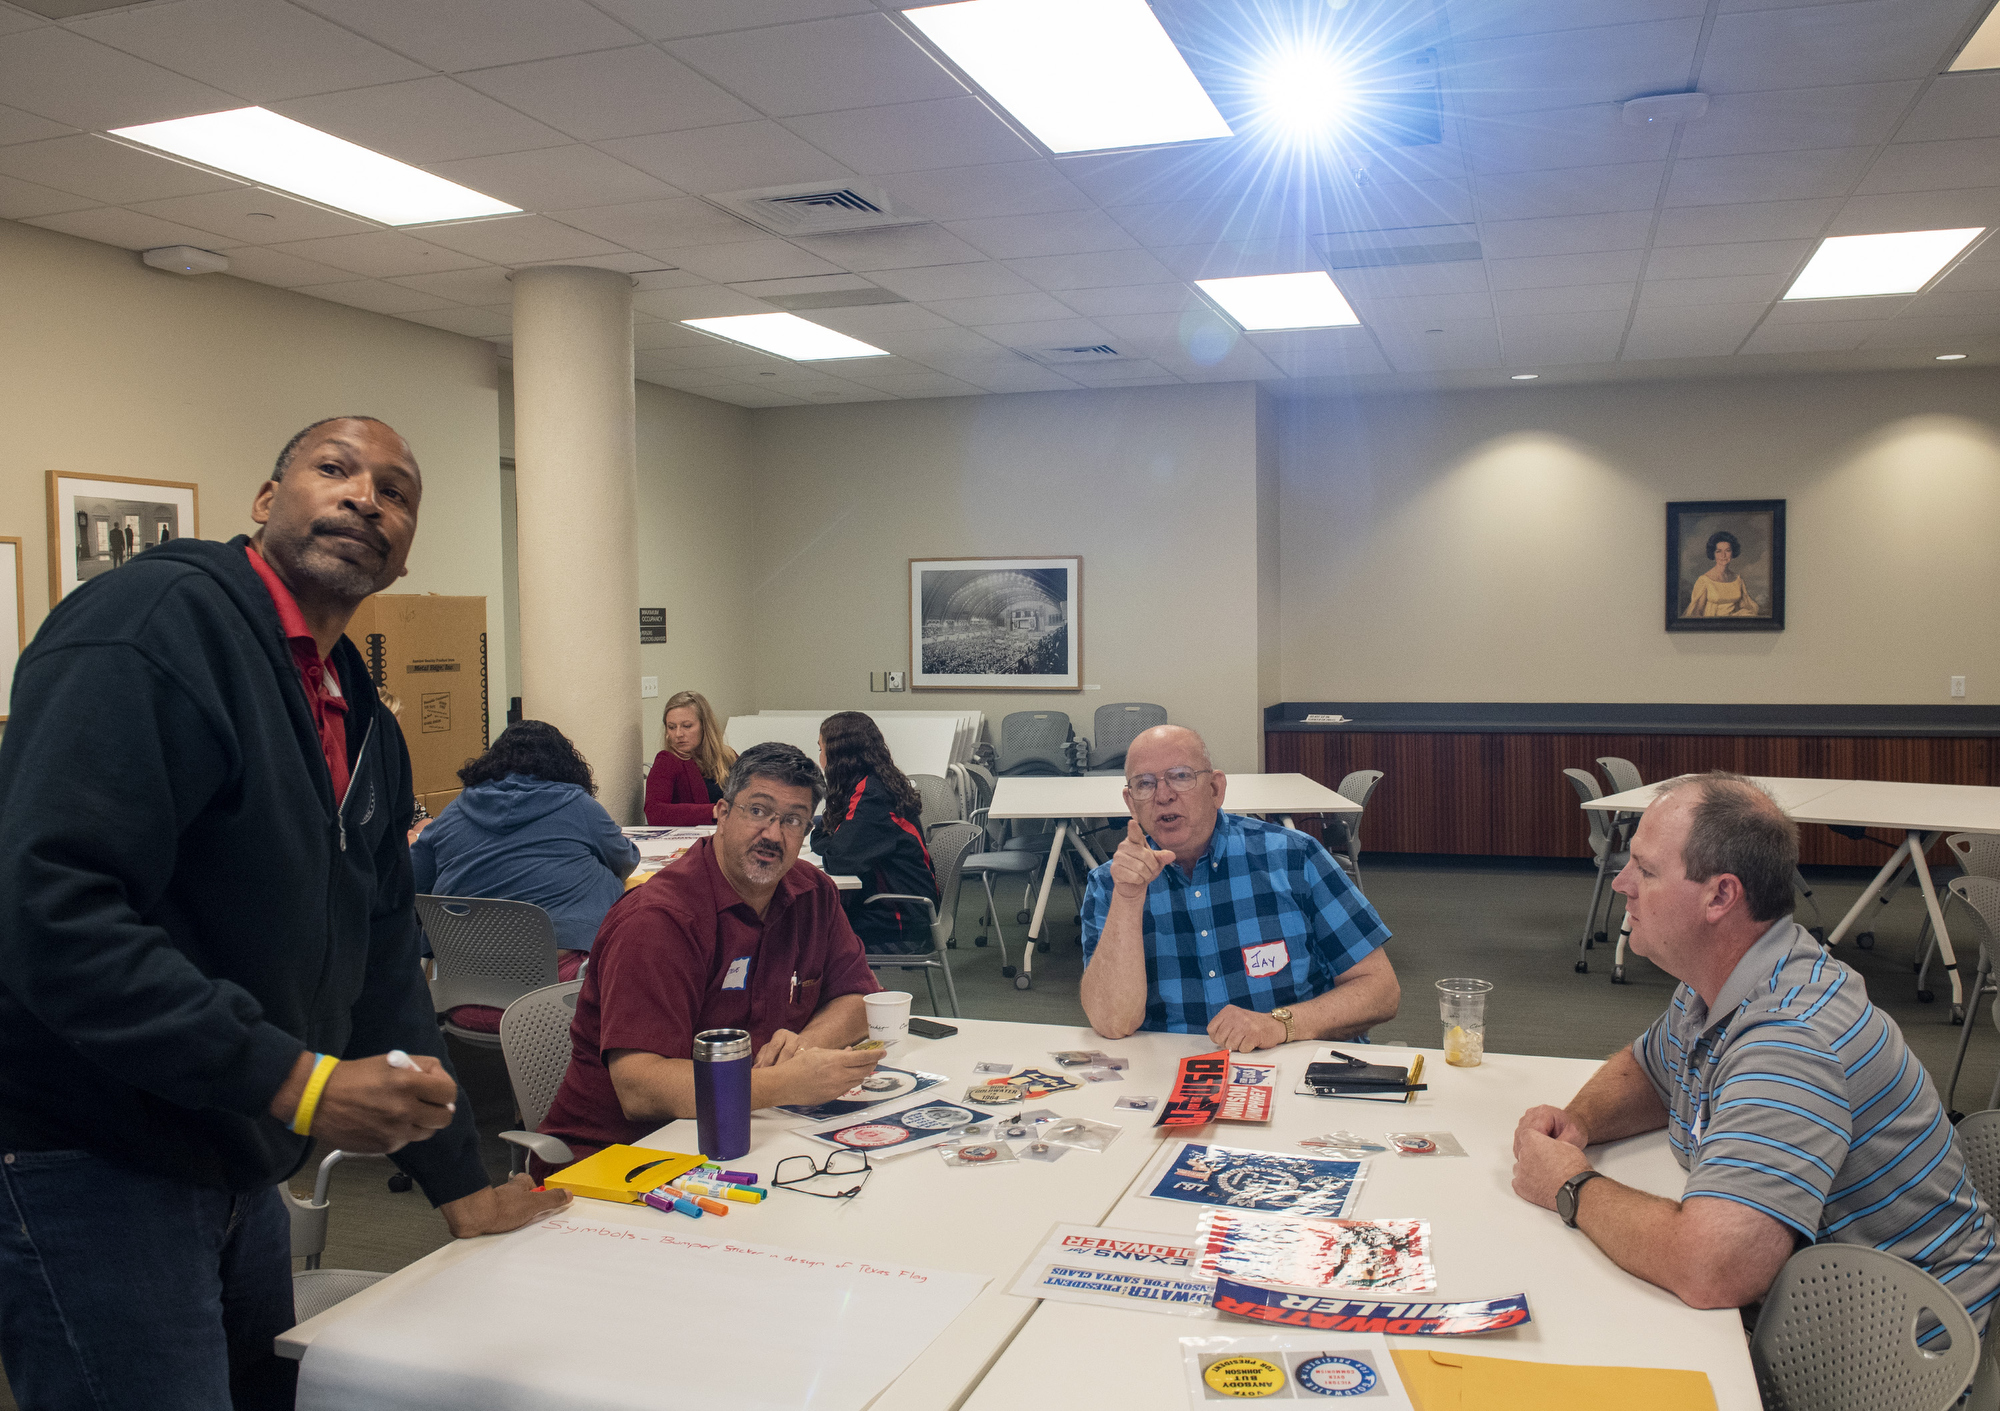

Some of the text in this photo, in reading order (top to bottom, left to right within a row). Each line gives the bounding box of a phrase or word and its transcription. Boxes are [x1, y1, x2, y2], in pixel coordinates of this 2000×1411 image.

[1251, 950, 1275, 968] JAY
[1180, 1059, 1225, 1096] USA
[1163, 1110, 1211, 1124] BJ
[1173, 1181, 1210, 1192] LBJ
[541, 1219, 636, 1241] Symbols
[784, 1256, 825, 1268] design
[835, 1261, 854, 1269] of
[858, 1264, 891, 1277] Texas
[898, 1269, 928, 1284] Flag
[1066, 1236, 1197, 1260] OLDWATER
[1094, 1249, 1190, 1267] EXANS
[1050, 1267, 1093, 1280] CLAUS
[1095, 1272, 1141, 1285] SANTA
[1043, 1276, 1122, 1293] PRESIDENT
[1143, 1279, 1170, 1288] FOR
[1128, 1285, 1212, 1306] LDWATER
[1211, 1359, 1276, 1373] FOR PRESIDENT
[1302, 1357, 1370, 1374] FOR PRESIDENT
[1305, 1382, 1371, 1396] GOLDWATER
